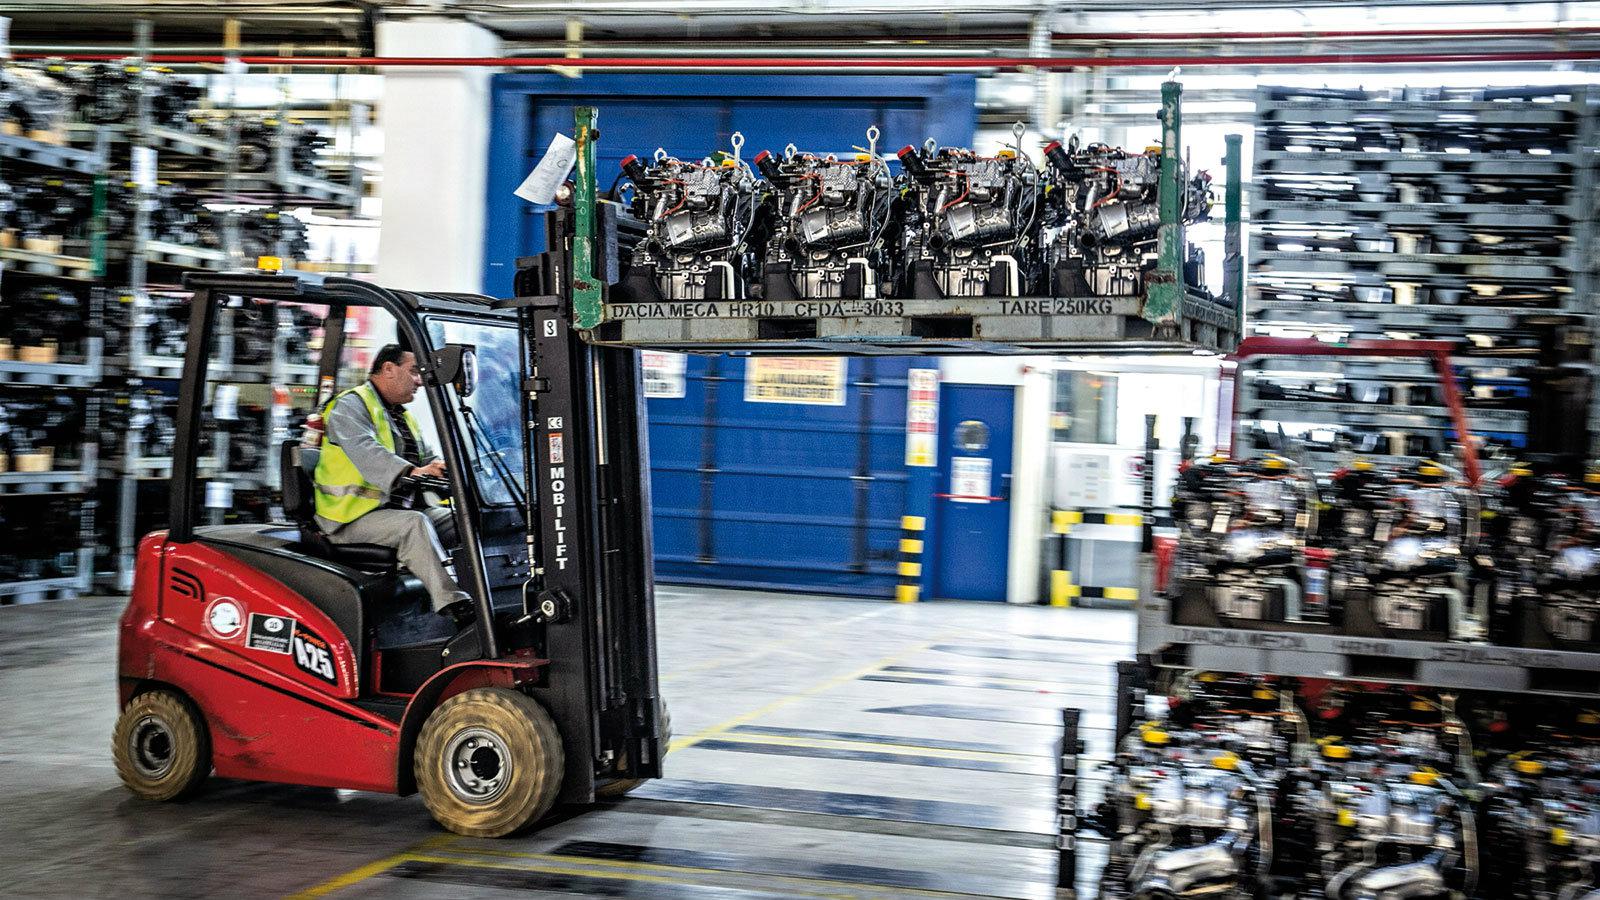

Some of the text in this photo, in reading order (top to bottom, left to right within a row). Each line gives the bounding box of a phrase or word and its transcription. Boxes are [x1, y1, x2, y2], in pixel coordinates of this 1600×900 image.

[612, 303, 664, 318] DACIA
[669, 303, 719, 317] MECA
[729, 303, 775, 317] HR10
[999, 300, 1113, 315] TARE 250KG
[548, 419, 562, 428] CE
[550, 467, 568, 570] MOBILIFT
[294, 636, 335, 680] A25
